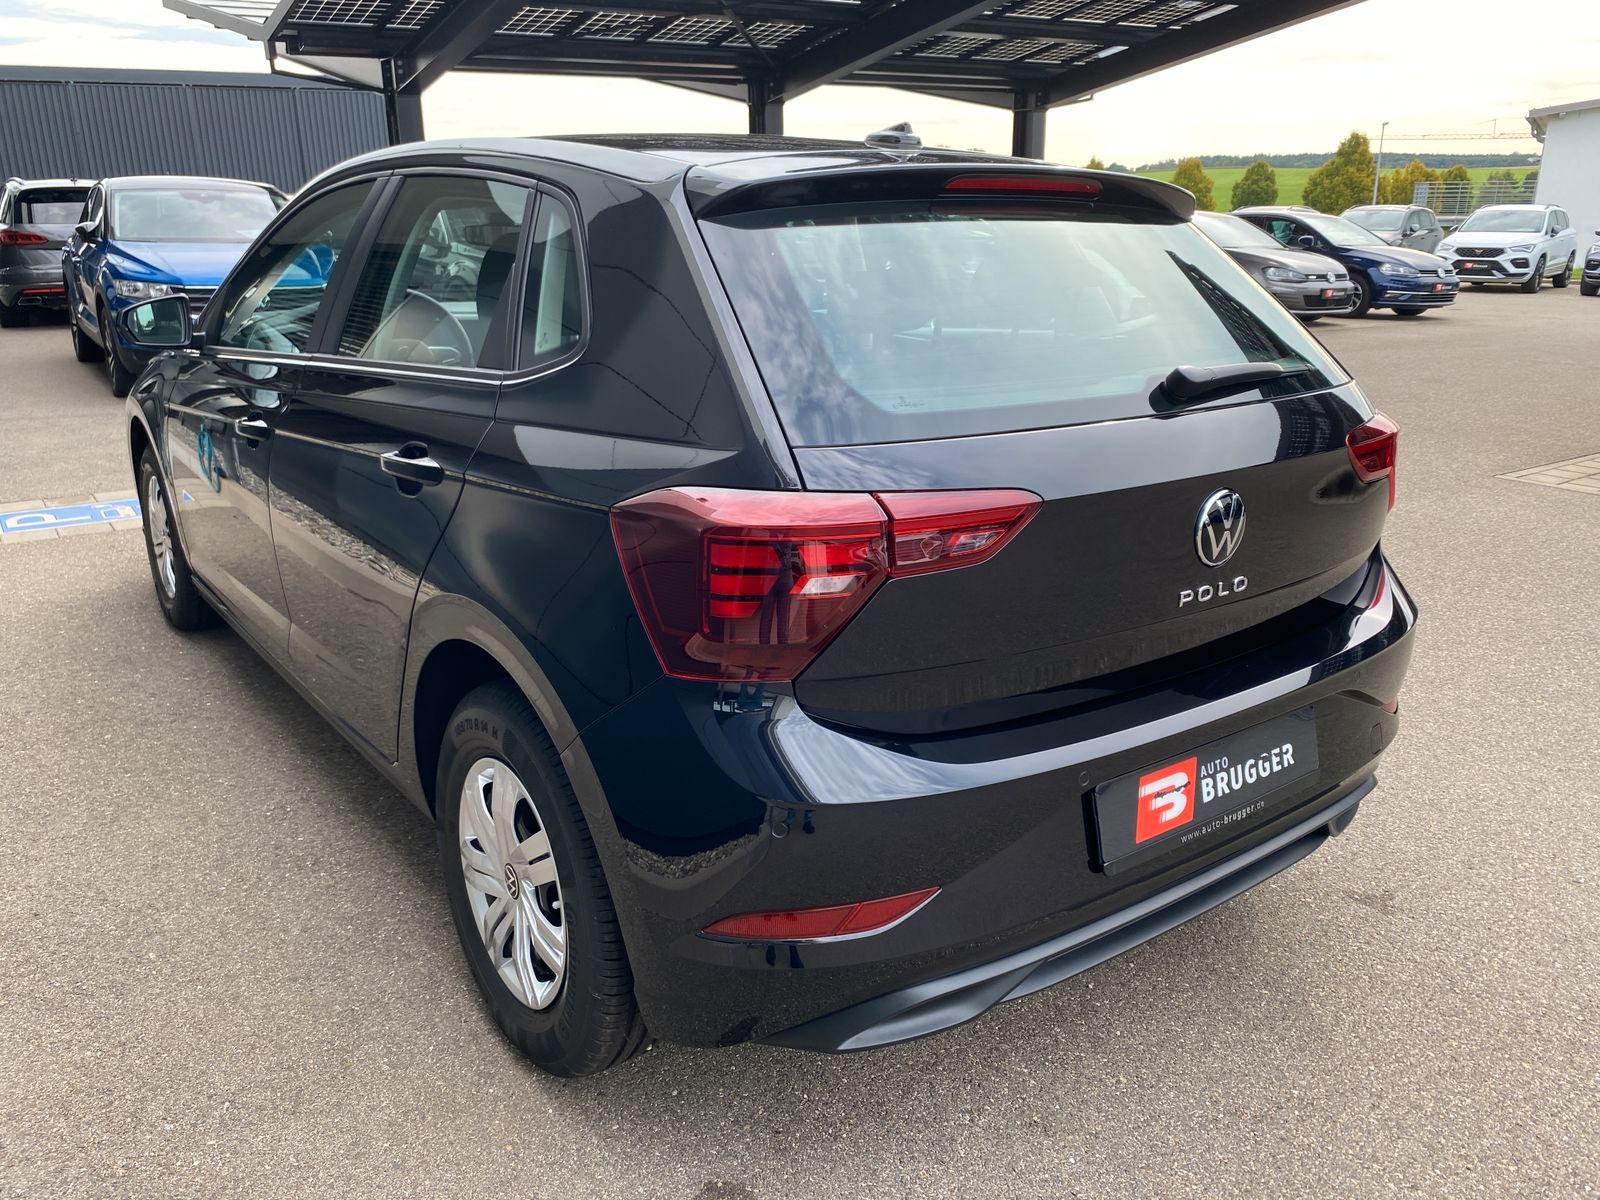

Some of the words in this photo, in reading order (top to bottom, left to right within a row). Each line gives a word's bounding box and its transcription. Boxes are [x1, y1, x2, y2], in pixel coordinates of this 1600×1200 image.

[1179, 575, 1249, 608] POLO
[1200, 756, 1229, 778] AUTO
[1201, 742, 1295, 804] BRUGGER
[1180, 800, 1265, 844] www.auto-brugger.de
